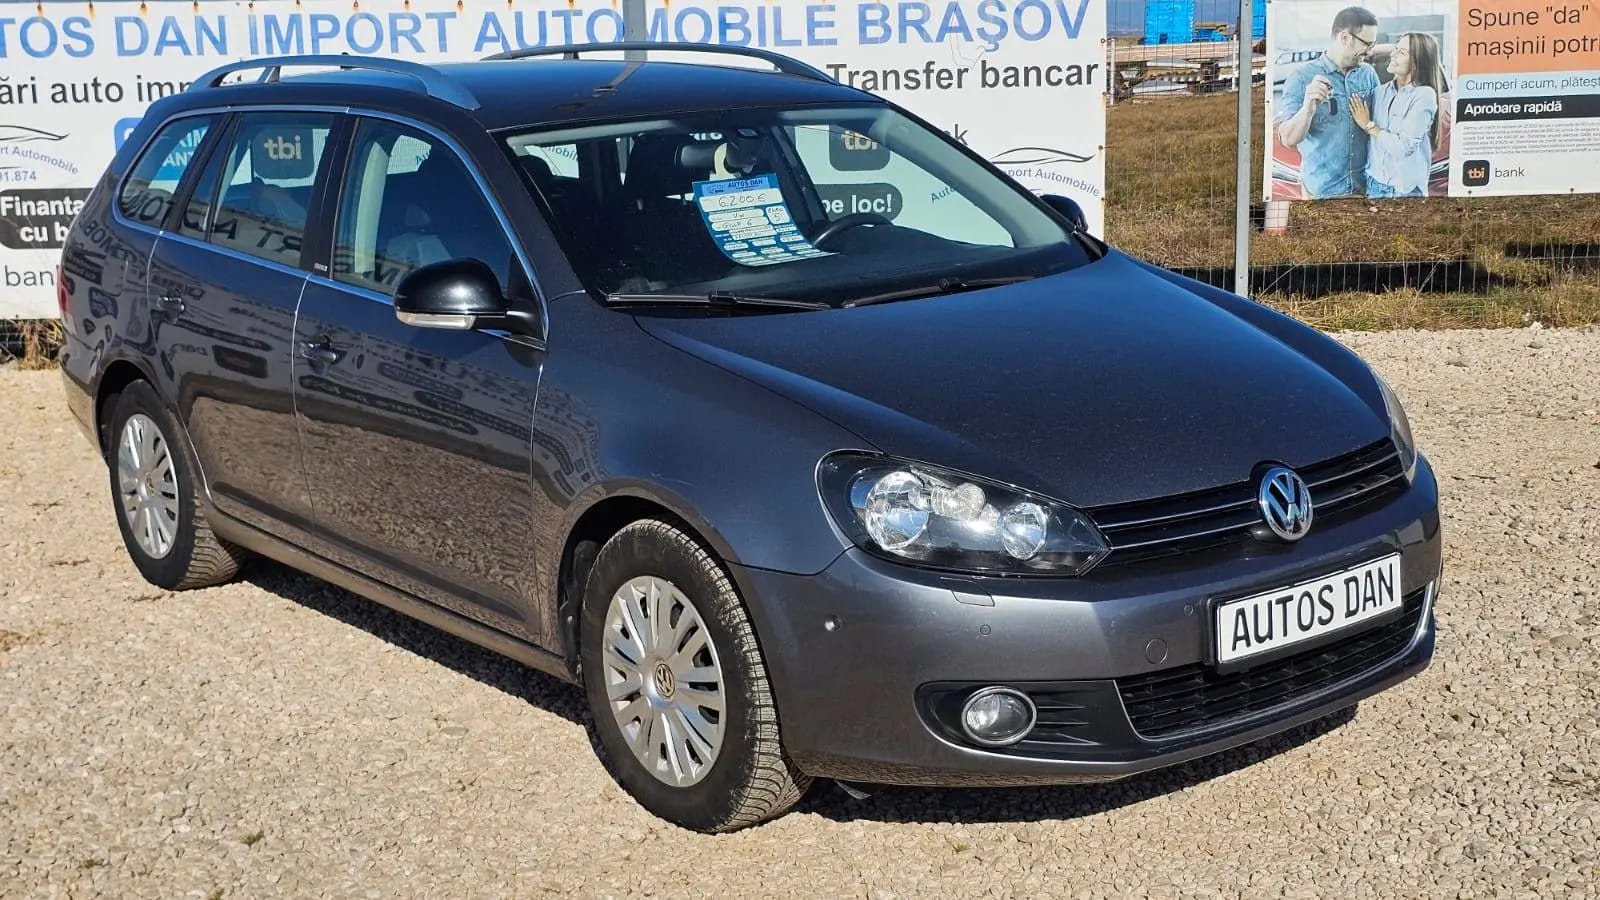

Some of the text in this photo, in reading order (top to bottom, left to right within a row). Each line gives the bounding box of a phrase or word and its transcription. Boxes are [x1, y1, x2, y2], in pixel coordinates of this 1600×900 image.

[1467, 5, 1589, 30] Spune "da"
[115, 14, 227, 57] DAN
[248, 11, 457, 56] IMPORT
[1467, 36, 1545, 59] mașinii
[826, 60, 1098, 90] Transfer bancar
[1465, 78, 1517, 92] Cumperi
[1521, 78, 1557, 90] acum,
[50, 76, 124, 103] auto
[1464, 100, 1562, 117] Aprobare rapidă
[263, 135, 302, 160] tbi
[12, 146, 79, 175] Automobile
[1467, 167, 1525, 179] tbi bank
[1035, 168, 1100, 197] Automobile
[852, 194, 893, 213] loc!
[20, 226, 49, 242] cu
[5, 264, 60, 287] ban
[1231, 563, 1394, 651] AUTOS DAN
